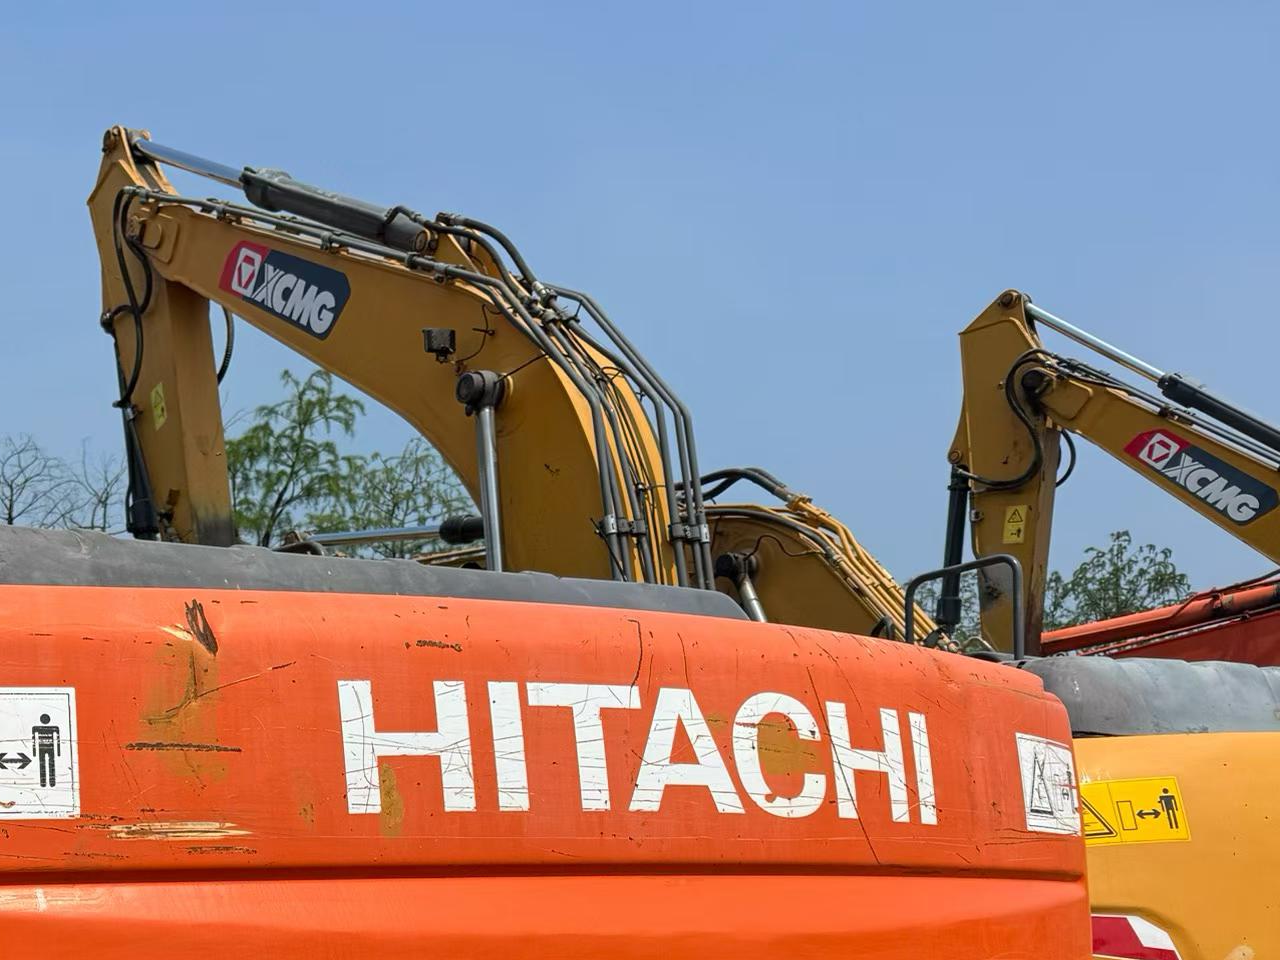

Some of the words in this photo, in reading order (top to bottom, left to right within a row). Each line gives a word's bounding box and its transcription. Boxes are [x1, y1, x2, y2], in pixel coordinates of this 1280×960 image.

[251, 262, 336, 334] XCMG
[1160, 452, 1260, 522] XCMG
[336, 679, 939, 826] HITACHI
